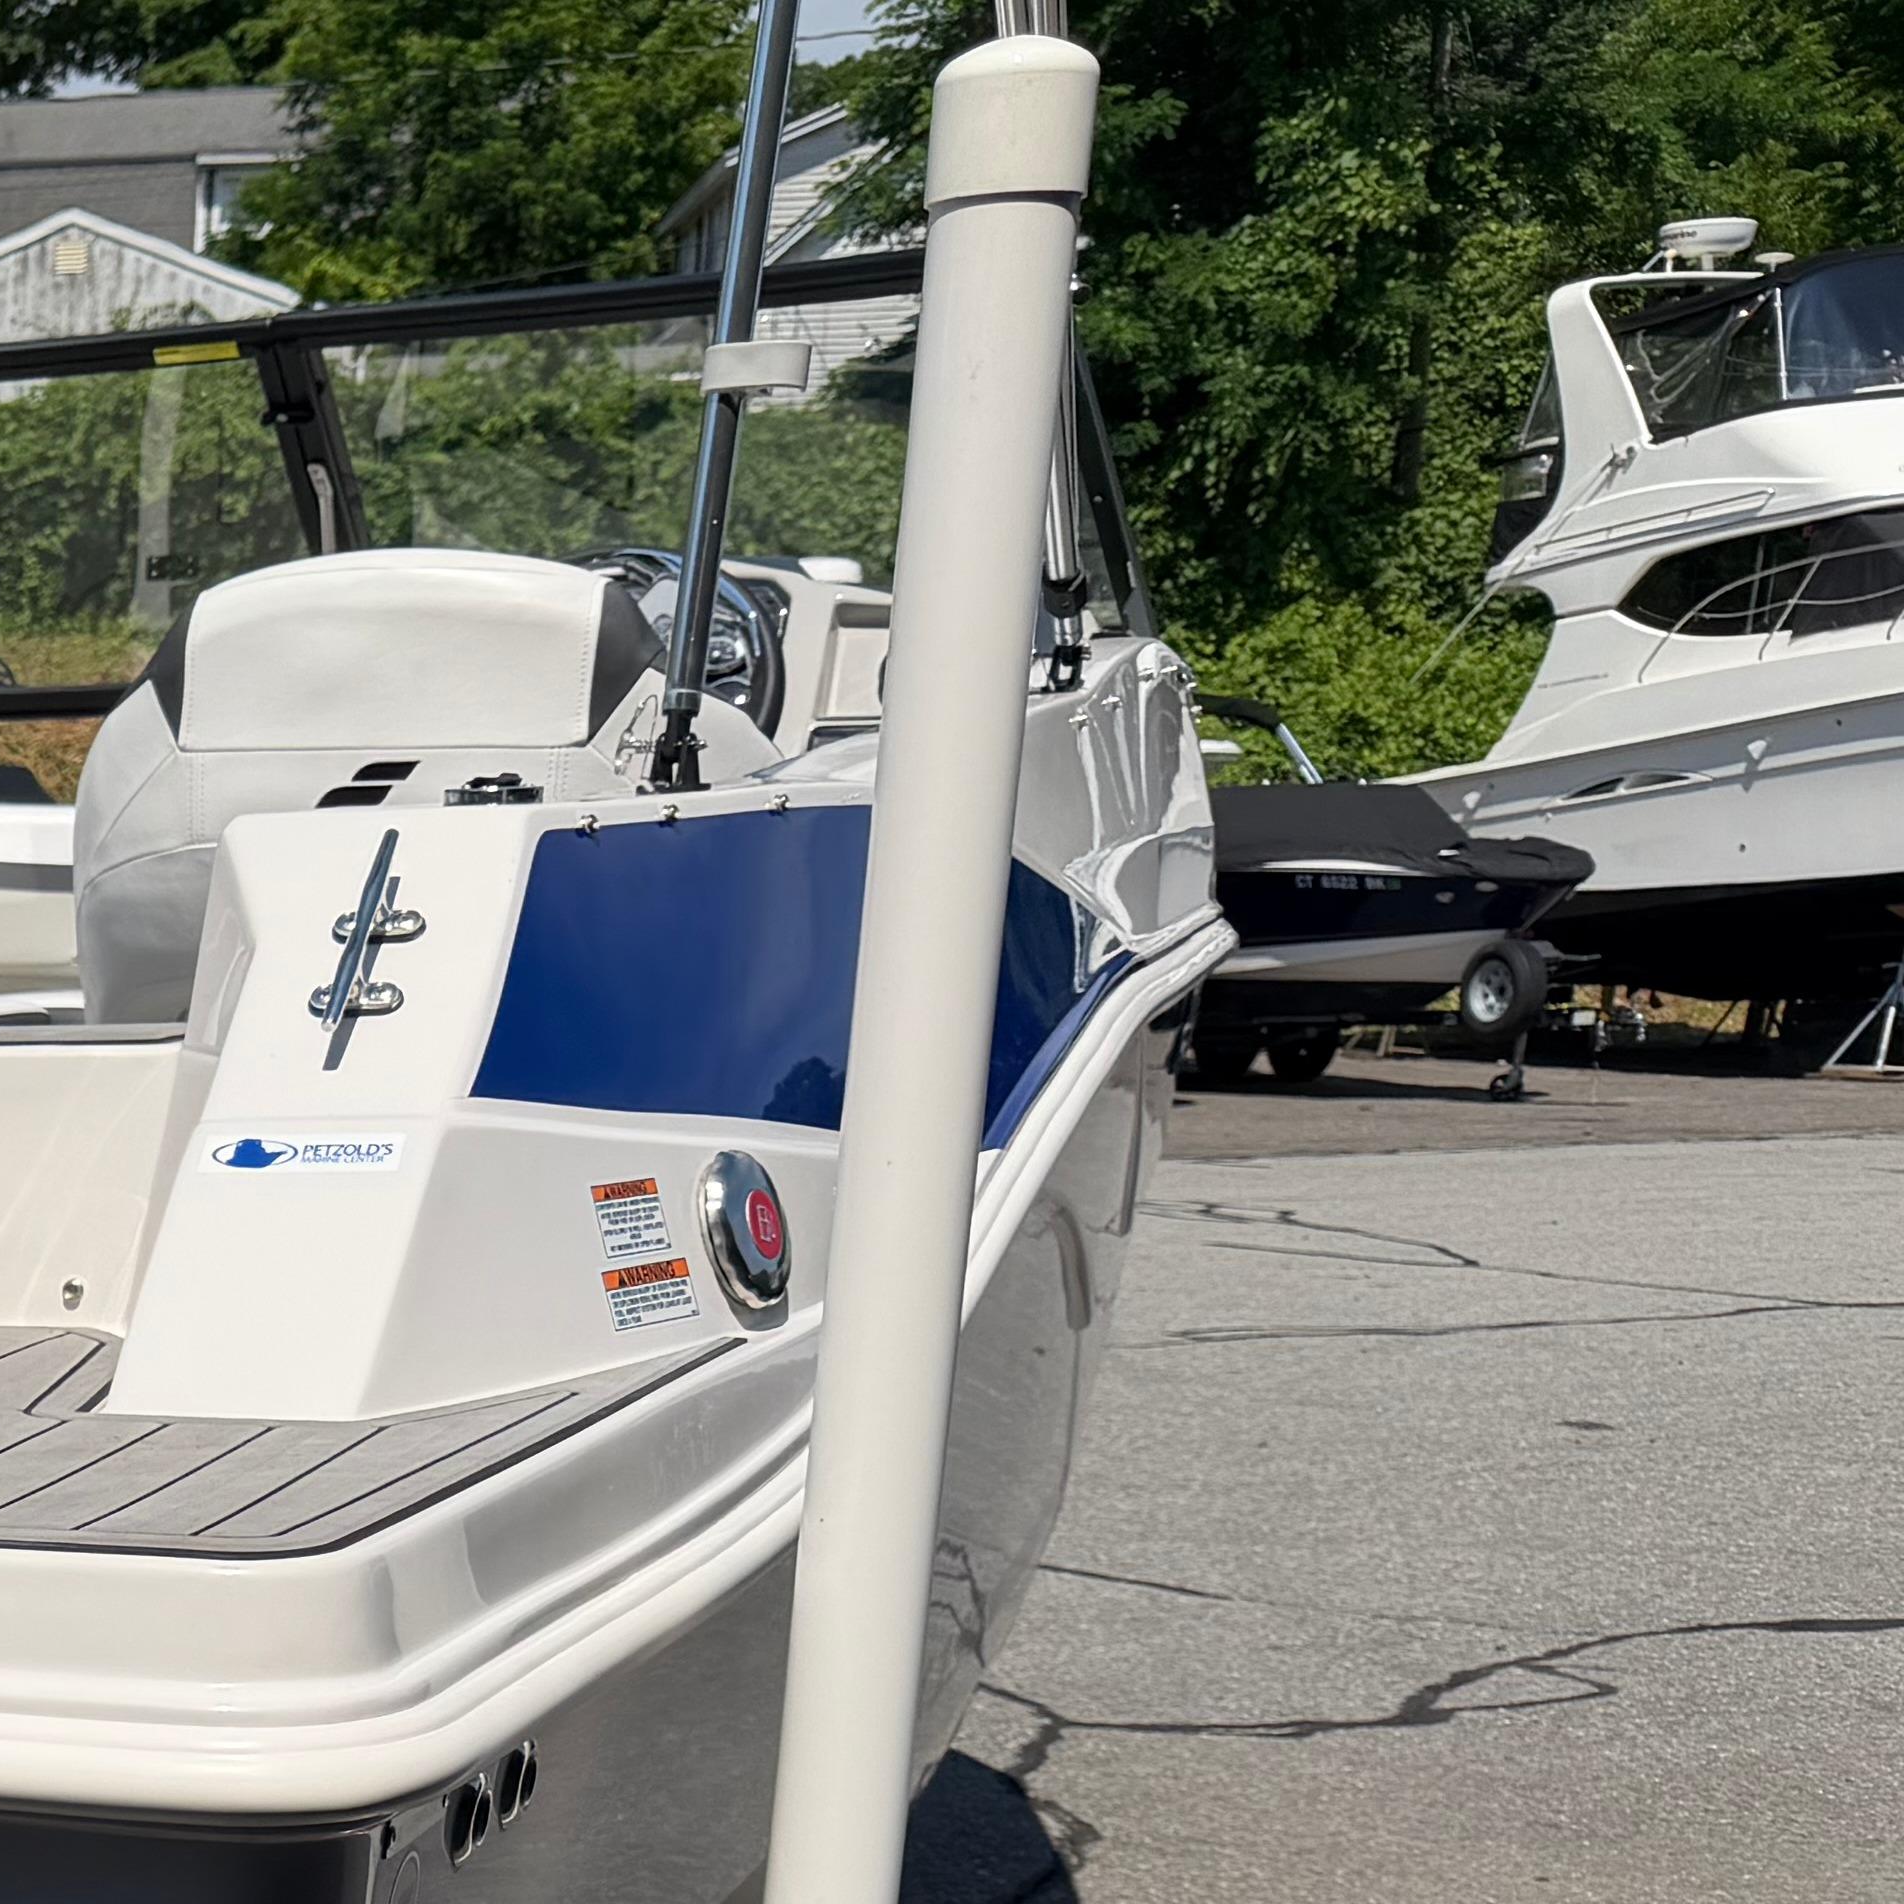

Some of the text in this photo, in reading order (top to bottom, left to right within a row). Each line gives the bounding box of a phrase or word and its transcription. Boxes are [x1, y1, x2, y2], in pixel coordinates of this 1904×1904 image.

[302, 1143, 393, 1157] PETZOLD'S
[344, 1155, 384, 1164] CENTER
[623, 1261, 676, 1288] WARNING
